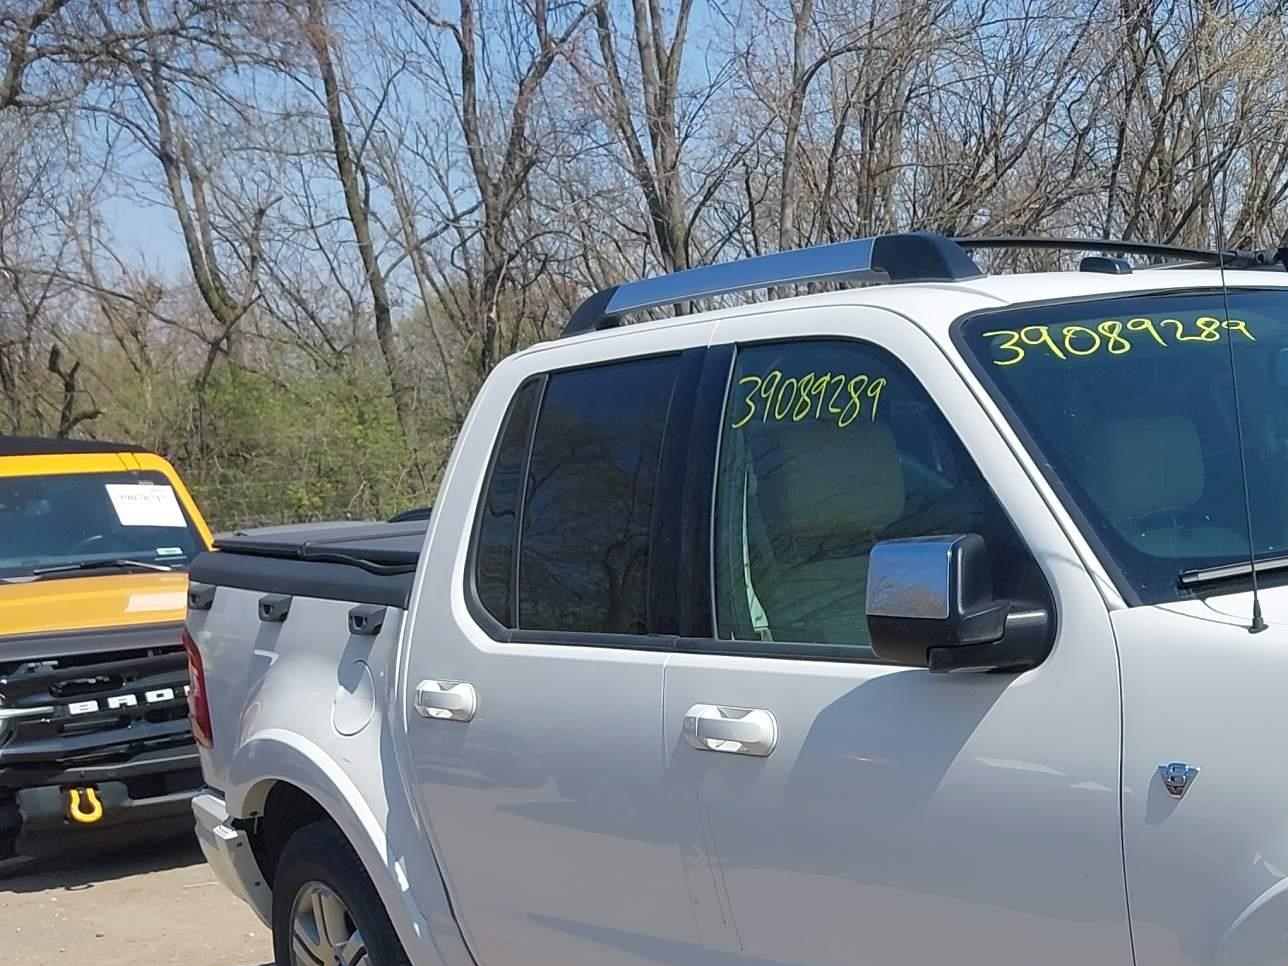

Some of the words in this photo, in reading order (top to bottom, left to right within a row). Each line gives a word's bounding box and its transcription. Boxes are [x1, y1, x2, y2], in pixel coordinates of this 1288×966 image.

[982, 317, 1256, 365] 39089289
[732, 370, 887, 428] 39089289
[68, 685, 190, 715] BRO
